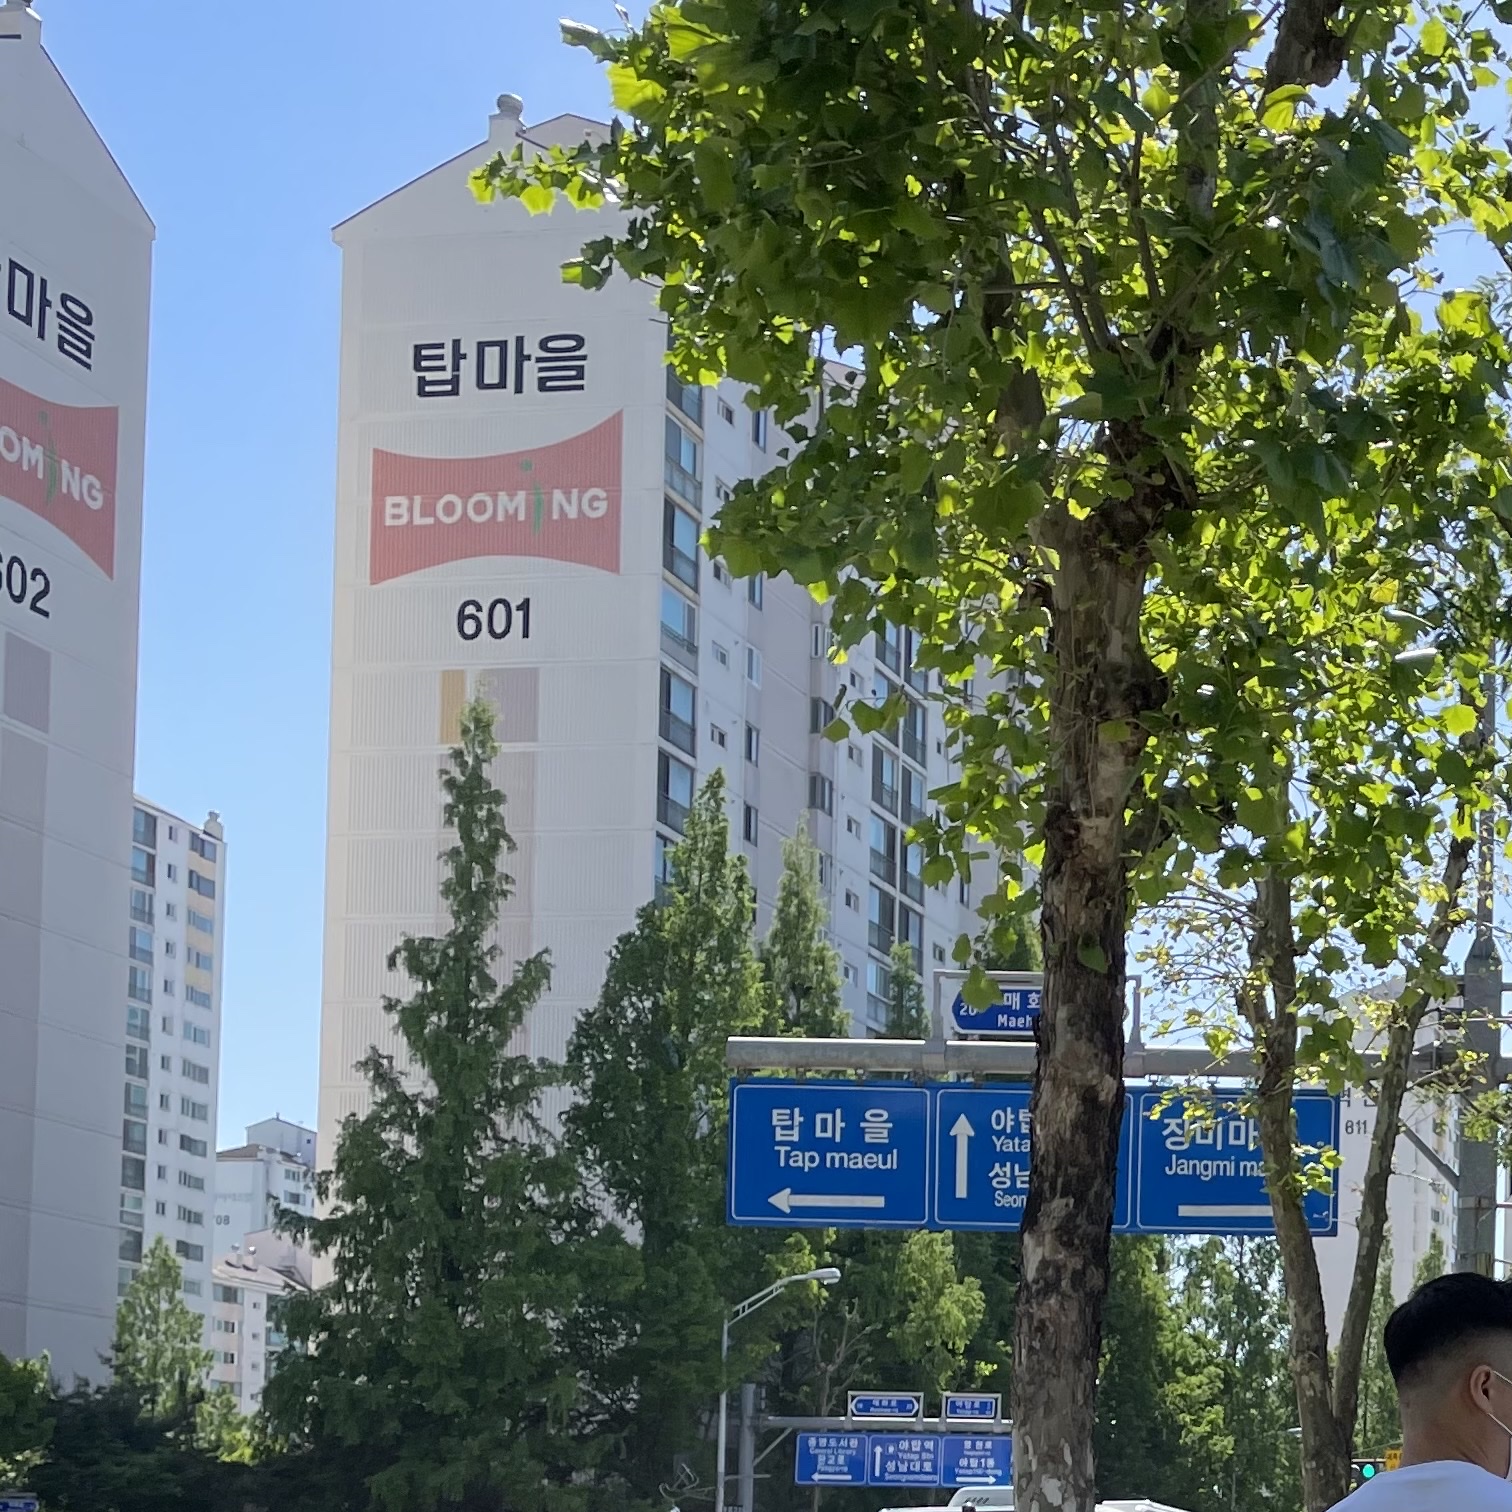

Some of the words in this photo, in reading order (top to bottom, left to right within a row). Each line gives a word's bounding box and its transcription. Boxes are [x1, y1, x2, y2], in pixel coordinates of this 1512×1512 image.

[413, 334, 588, 397] 탑마을
[384, 466, 609, 534] BLOOMING
[0, 552, 50, 619] 02
[457, 597, 530, 641] 601
[772, 1107, 893, 1143] 탑마을
[1345, 1120, 1367, 1135] 811
[774, 1146, 820, 1172] Tap
[826, 1148, 898, 1169] maeul
[1165, 1153, 1235, 1181] Jangmi
